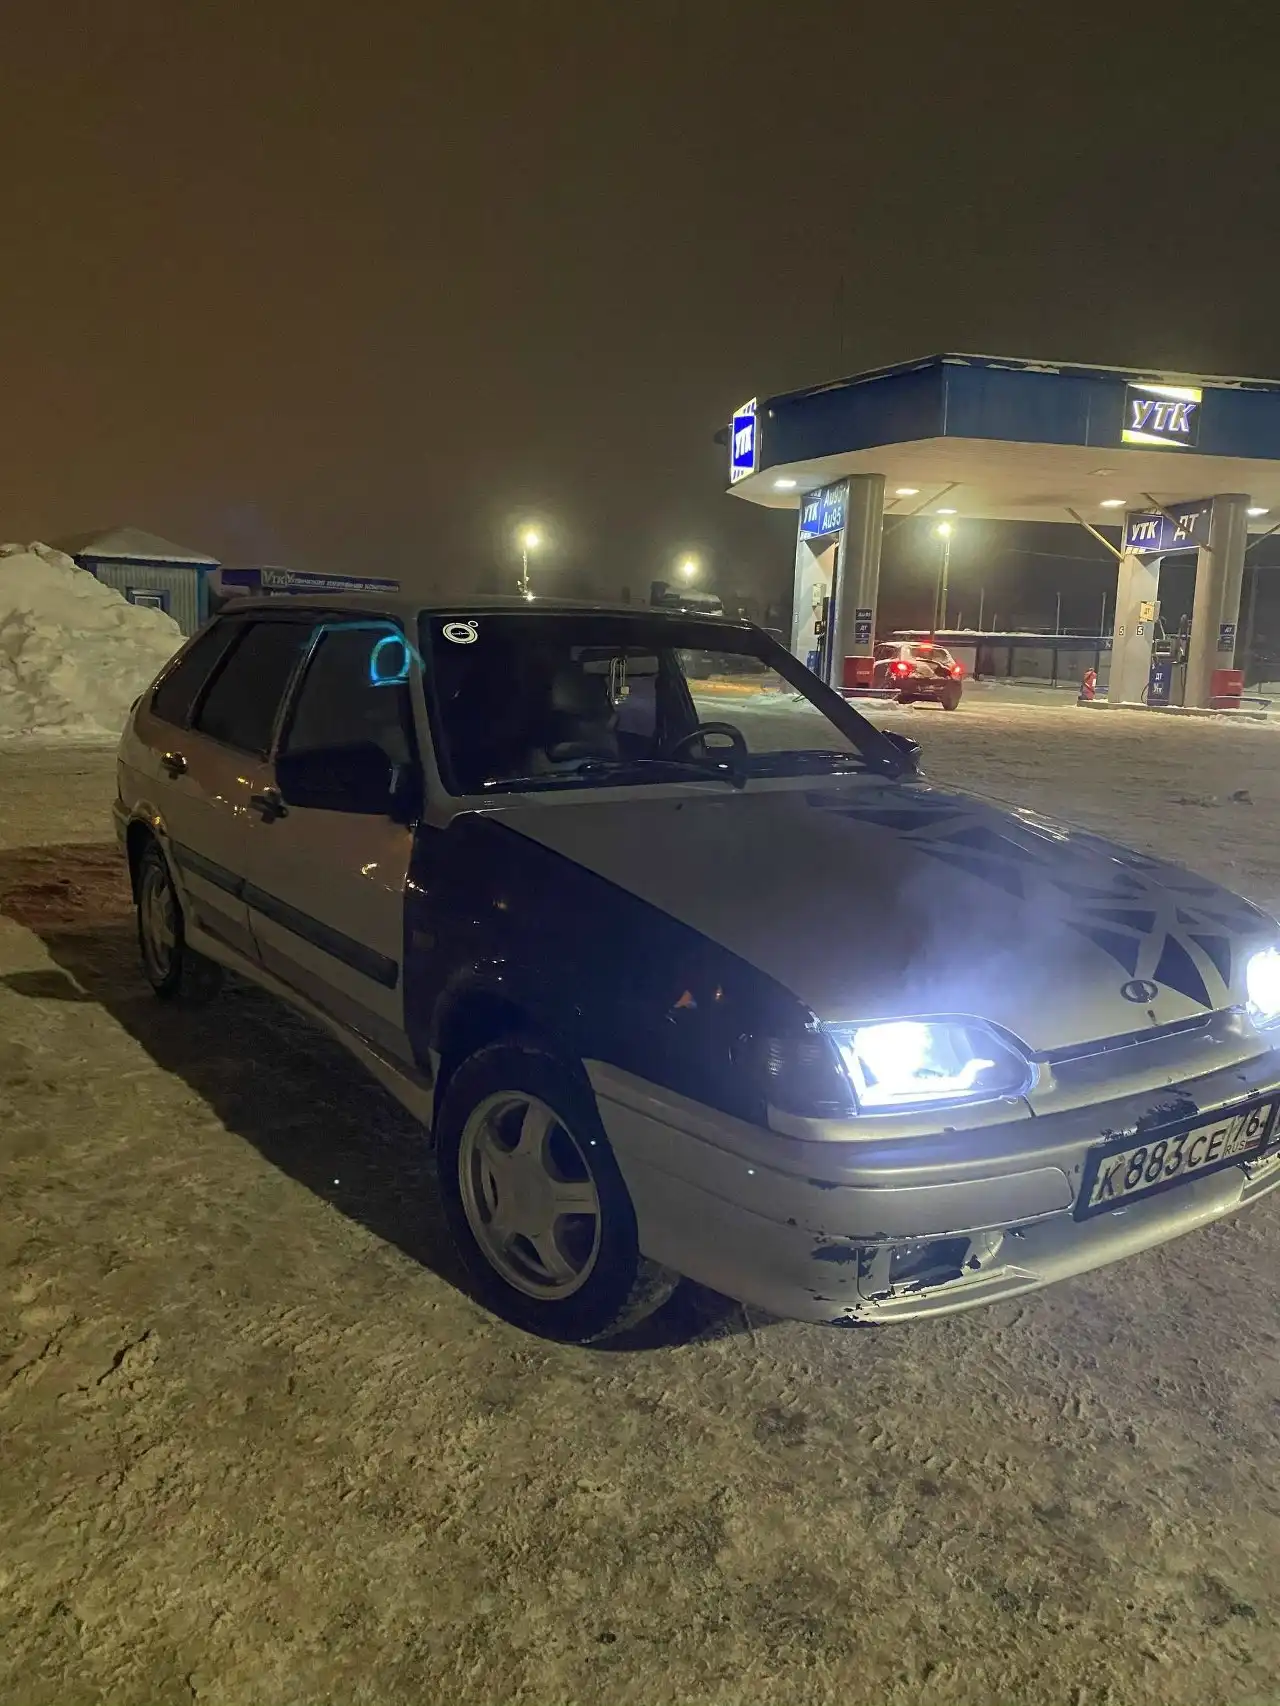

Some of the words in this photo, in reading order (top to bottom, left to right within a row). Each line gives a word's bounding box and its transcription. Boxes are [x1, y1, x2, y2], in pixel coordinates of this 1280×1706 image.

[1132, 400, 1196, 432] УТК
[735, 424, 753, 459] УТК
[803, 501, 820, 524] УТК
[1131, 521, 1158, 541] УТК
[1173, 513, 1199, 541] ДТ
[1226, 1140, 1246, 1155] RUS
